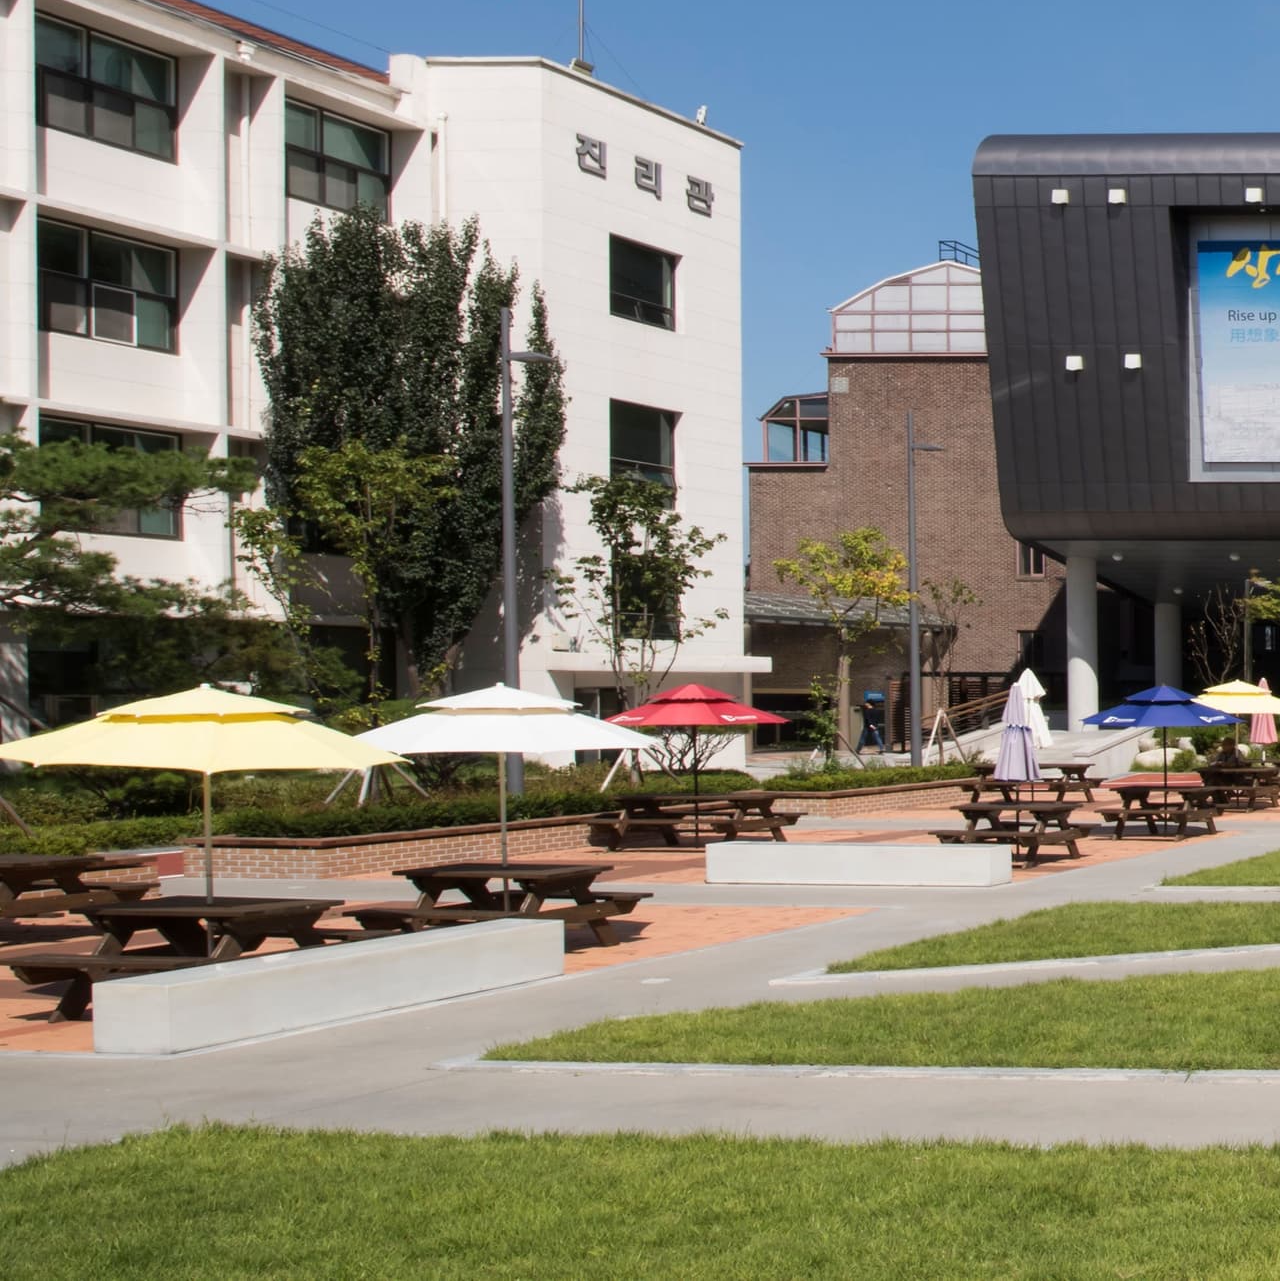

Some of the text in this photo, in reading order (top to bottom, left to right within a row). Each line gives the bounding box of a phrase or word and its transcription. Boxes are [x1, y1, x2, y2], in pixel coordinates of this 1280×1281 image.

[576, 133, 714, 218] 진리관
[1228, 309, 1255, 322] Rise
[1259, 312, 1277, 324] up
